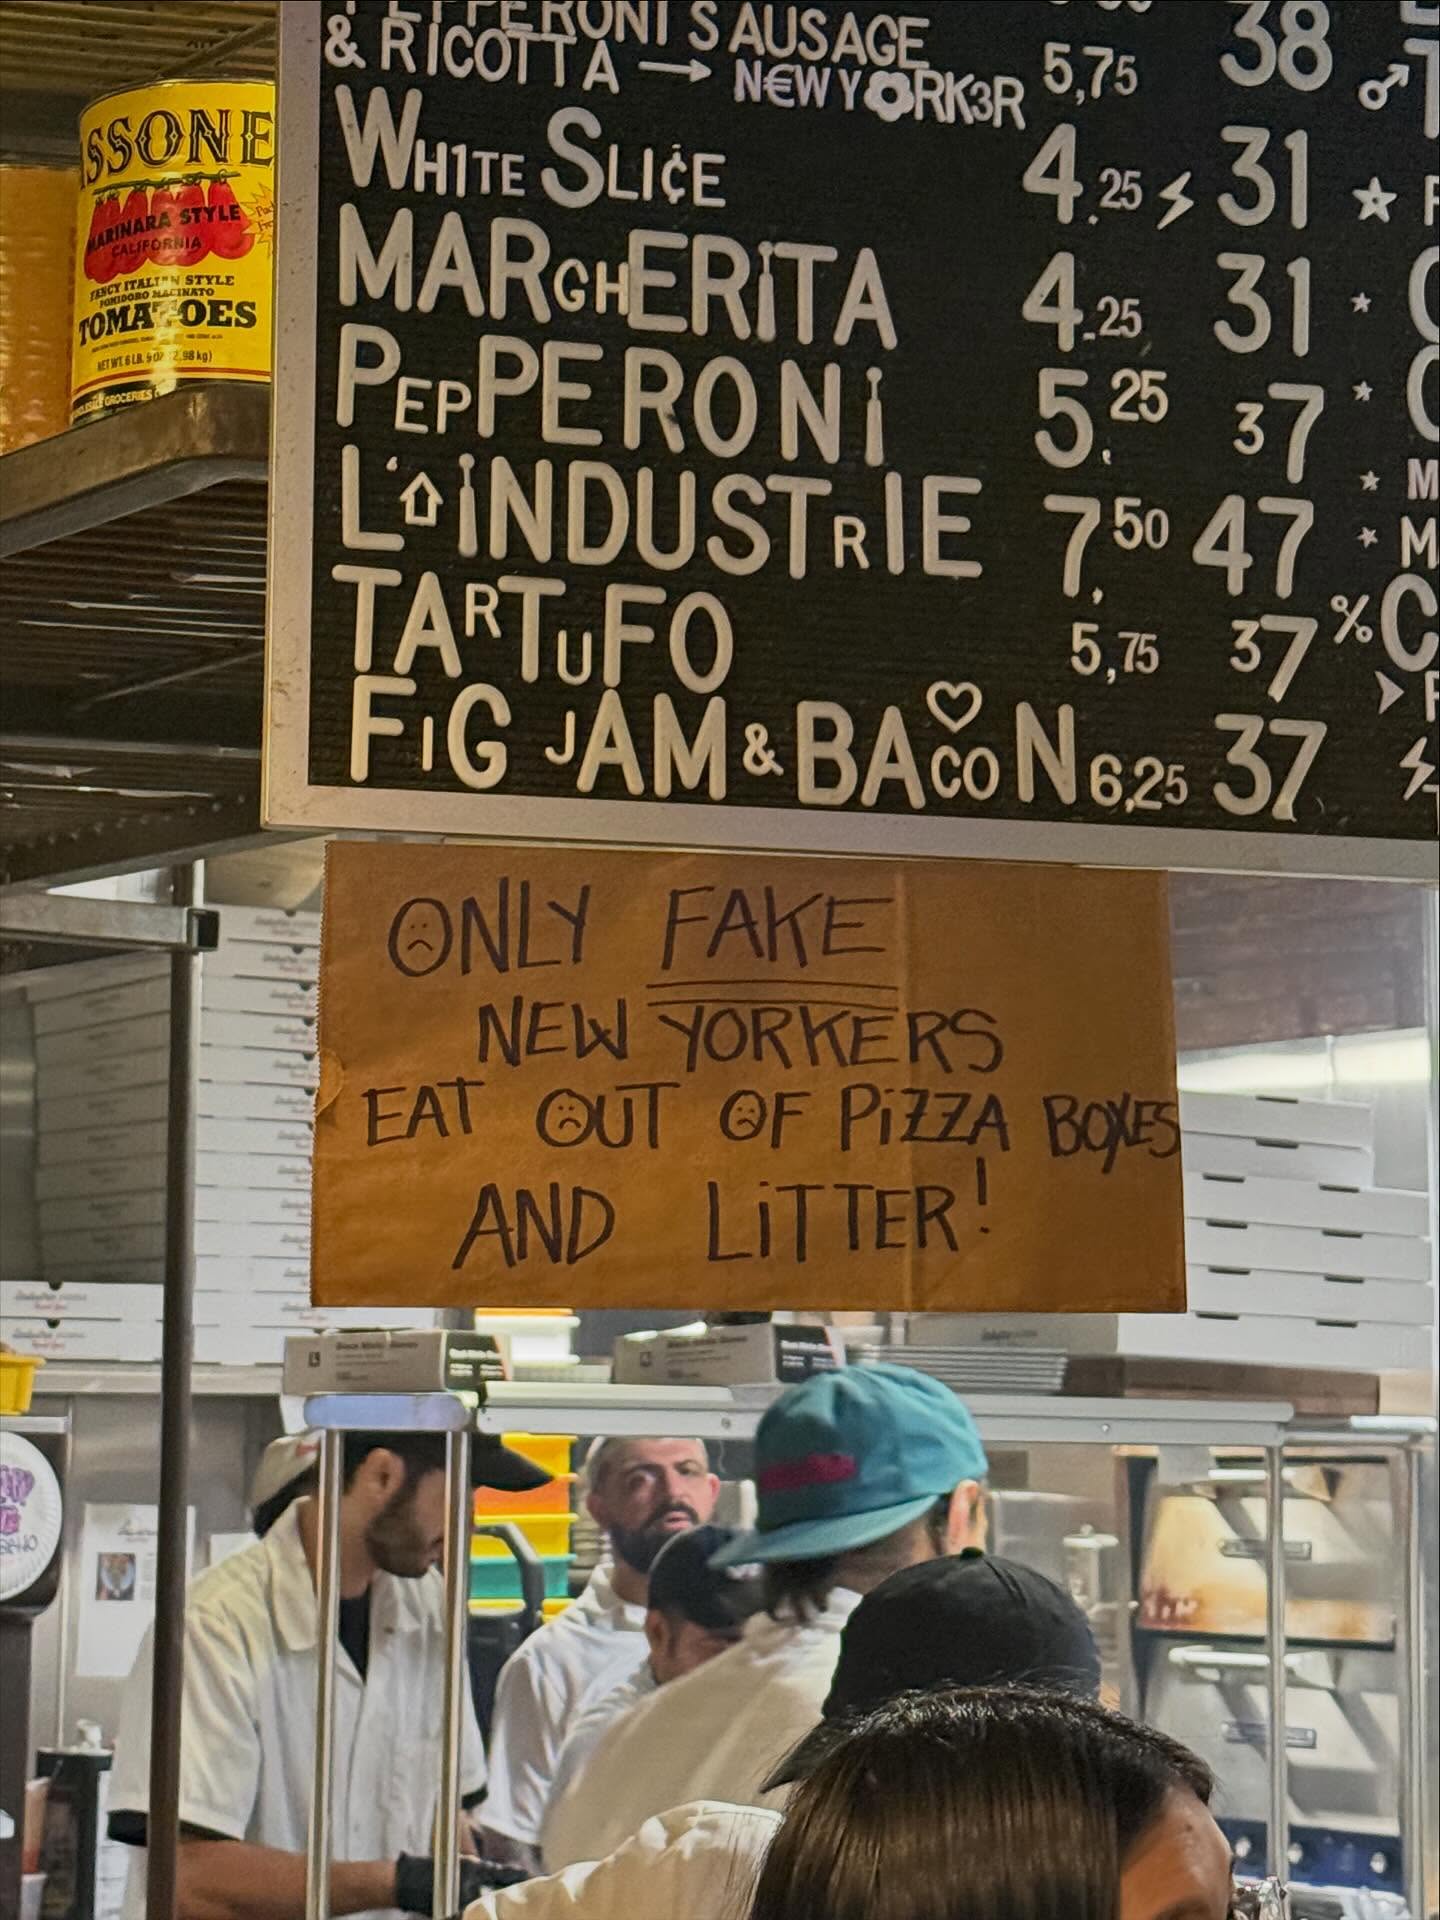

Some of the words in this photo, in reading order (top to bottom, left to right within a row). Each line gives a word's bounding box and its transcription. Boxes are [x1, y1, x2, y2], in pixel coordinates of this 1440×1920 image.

[325, 10, 366, 68] &
[380, 18, 620, 95] RICOTTA
[1044, 42, 1137, 104] 5,75
[688, 2, 930, 69] SAUSAGE
[1221, 2, 1332, 91] 38
[81, 109, 273, 190] SSONE
[1218, 126, 1307, 229] 31
[87, 211, 172, 254] MARINARA
[179, 204, 241, 225] STYLE
[111, 236, 202, 258] CALIFORNIA
[185, 275, 235, 287] STYLE
[1214, 253, 1310, 356] 31
[1234, 383, 1324, 483] 37
[1193, 495, 1313, 599] 47
[331, 564, 734, 694] TARTUFO
[1231, 615, 1318, 702] 37
[350, 675, 512, 789] FIG
[545, 689, 727, 800] JAM
[743, 723, 783, 775] &
[797, 700, 1077, 810] BACON
[1214, 714, 1327, 821] 37
[388, 877, 591, 977] ONLY
[662, 886, 895, 970] FAKE
[479, 996, 628, 1067] NEW
[659, 1005, 1004, 1073] YORKERS
[362, 1077, 485, 1146] EAT
[536, 1082, 681, 1149] OUT
[720, 1088, 812, 1149] OF
[1043, 1092, 1181, 1174] BOXES
[452, 1181, 615, 1270] AND
